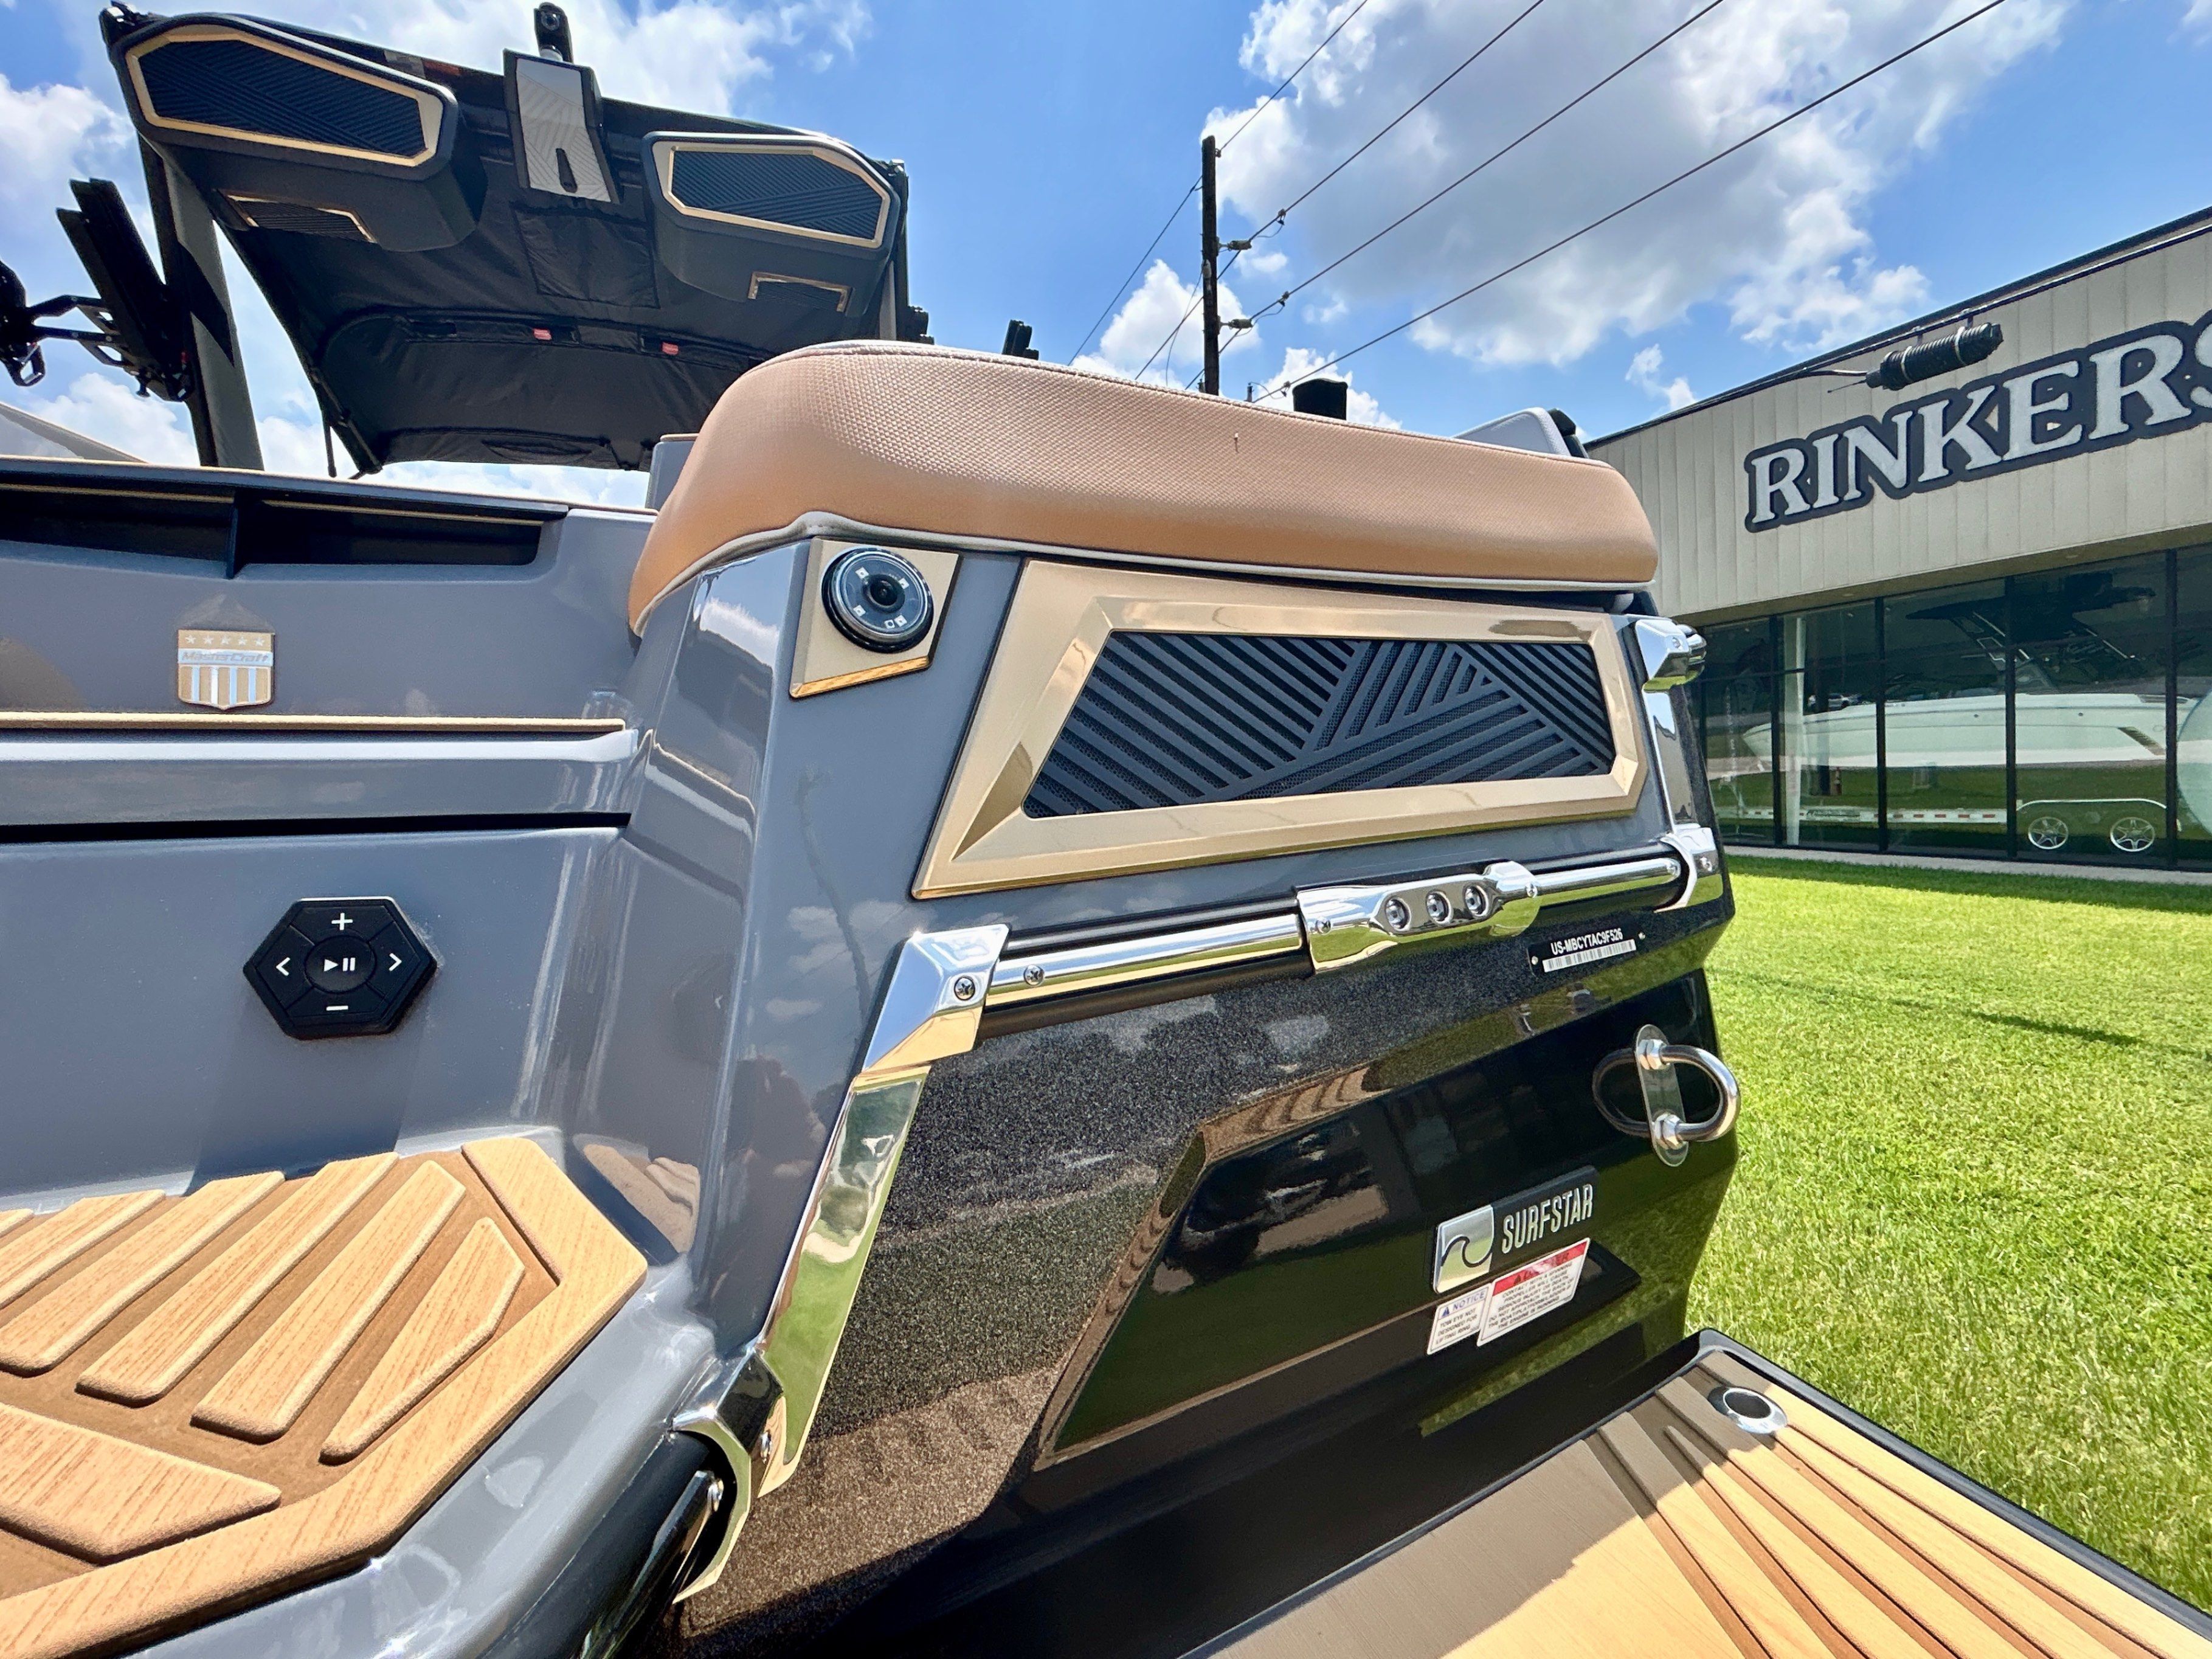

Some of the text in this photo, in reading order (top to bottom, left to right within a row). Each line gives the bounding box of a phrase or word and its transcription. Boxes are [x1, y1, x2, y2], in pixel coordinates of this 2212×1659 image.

[1550, 927, 1623, 955] US-MBCYTAC9F526
[1501, 1183, 1594, 1254] SURFSTAR
[1453, 1290, 1485, 1311] NOTICE
